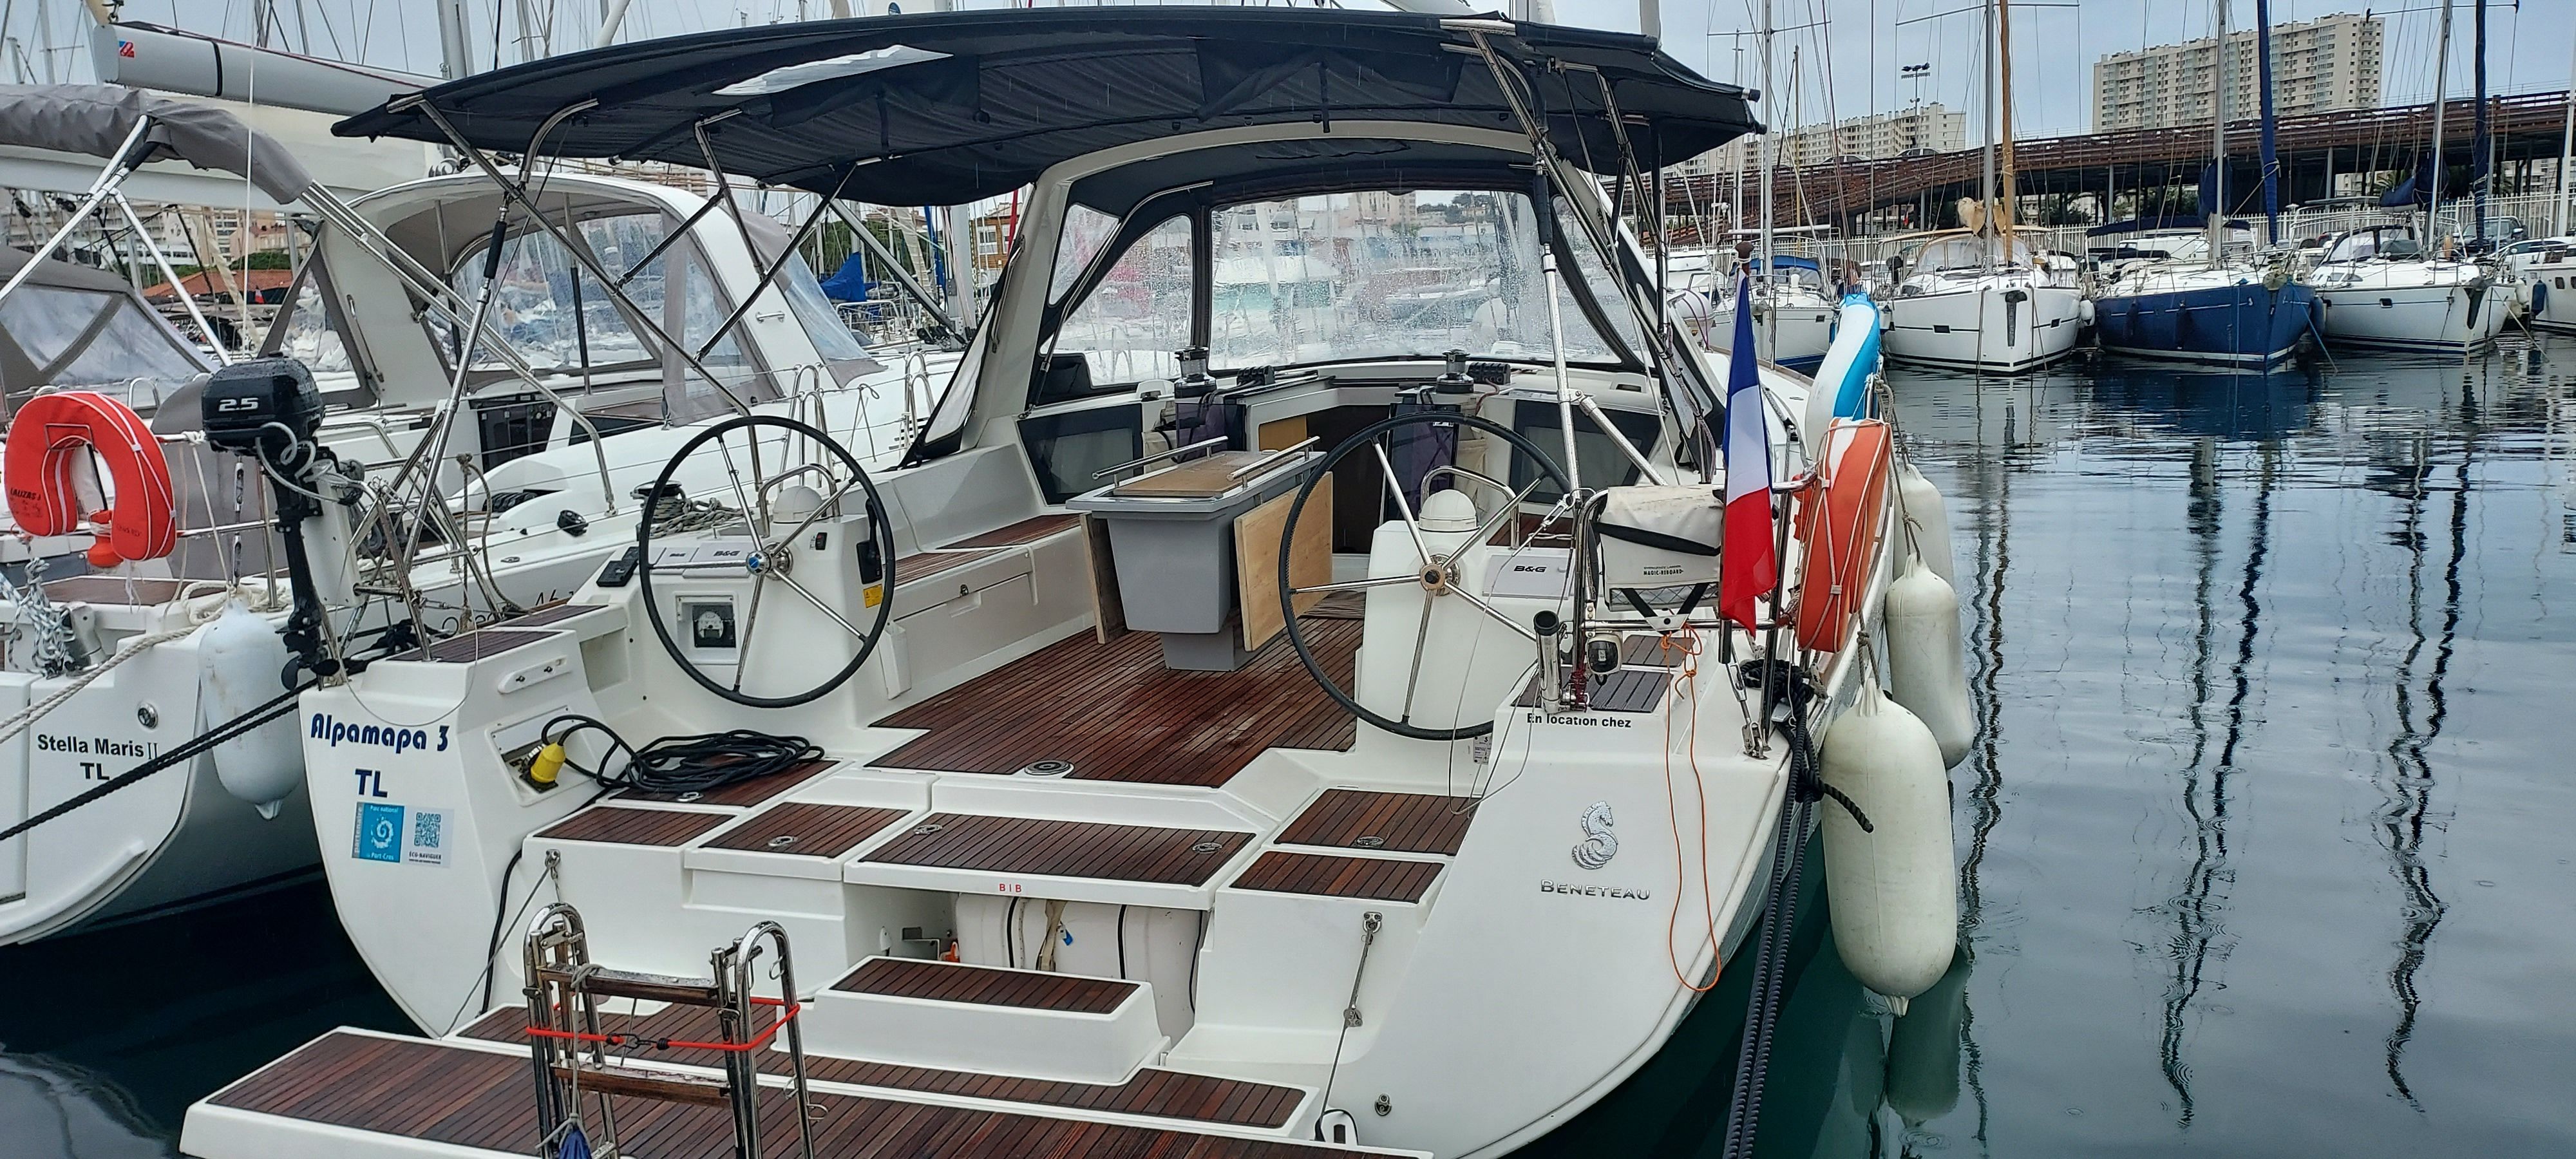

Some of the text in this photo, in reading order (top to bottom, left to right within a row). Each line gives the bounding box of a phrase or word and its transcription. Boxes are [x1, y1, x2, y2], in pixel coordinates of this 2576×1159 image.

[219, 397, 259, 411] 2.5
[1527, 713, 1631, 728] En location chez
[310, 713, 450, 754] Alpamapa 3
[37, 734, 89, 753] Stella
[94, 738, 144, 757] Maris
[80, 762, 110, 780] TL
[355, 768, 388, 798] TL
